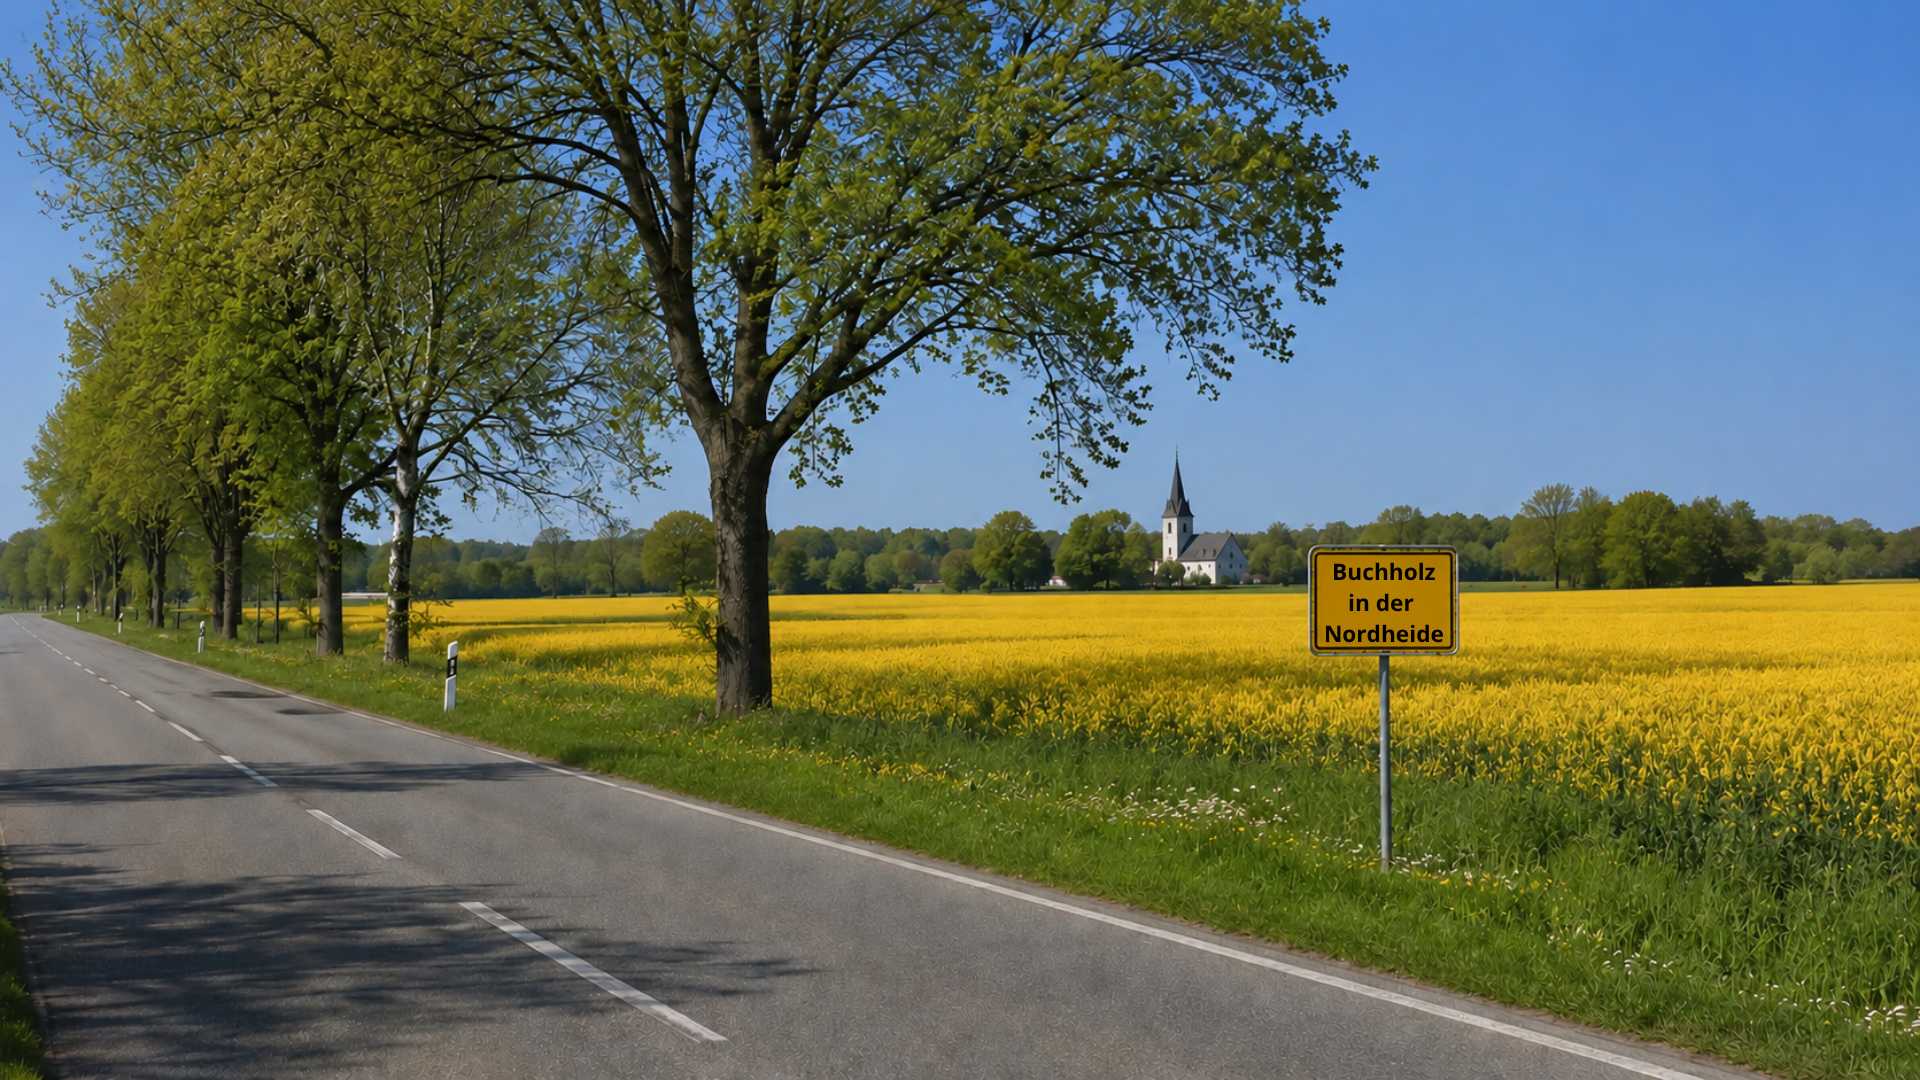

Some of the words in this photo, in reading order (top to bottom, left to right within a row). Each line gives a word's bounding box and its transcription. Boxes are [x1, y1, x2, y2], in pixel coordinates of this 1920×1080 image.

[1333, 563, 1436, 581] Buchholz
[1349, 594, 1369, 612] in
[1376, 594, 1414, 612] der
[1325, 624, 1444, 643] Nordheide
